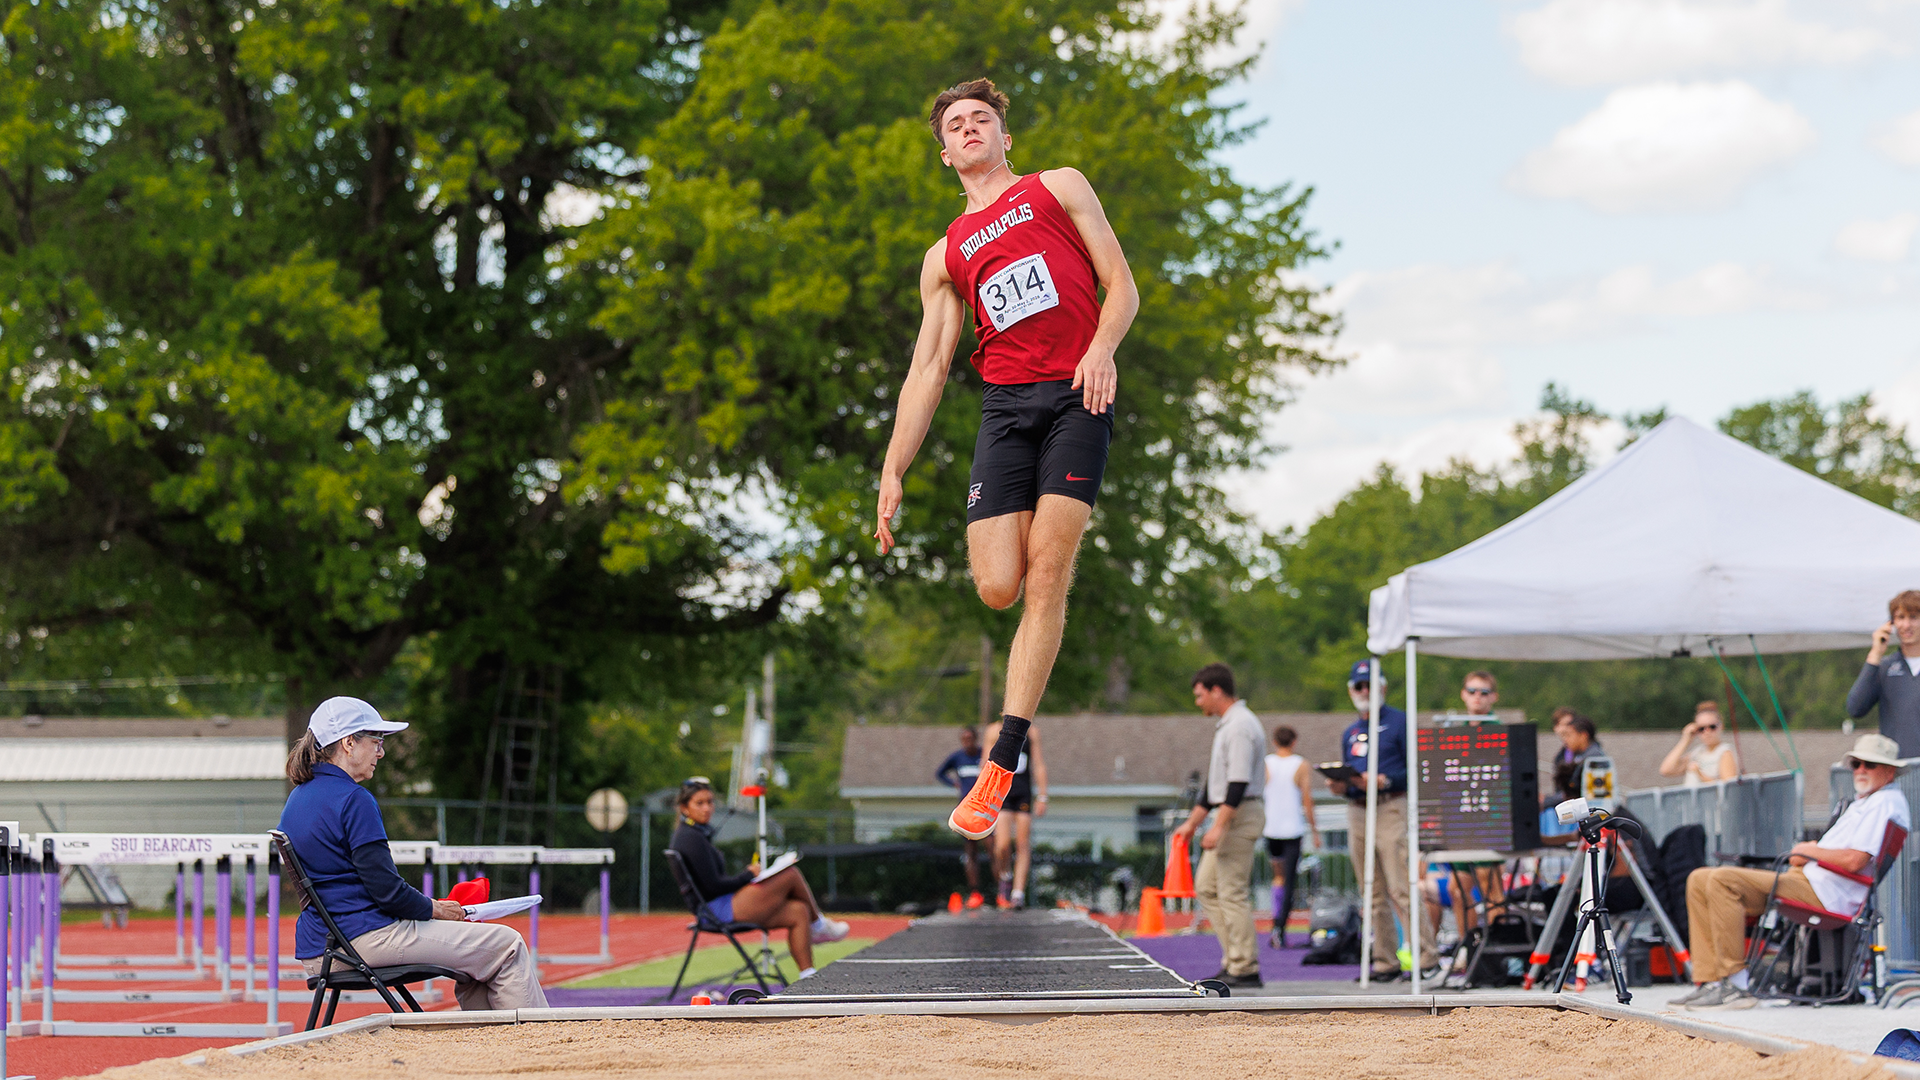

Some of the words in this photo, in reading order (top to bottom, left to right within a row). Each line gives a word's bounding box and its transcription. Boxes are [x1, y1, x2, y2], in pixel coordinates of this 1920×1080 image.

[959, 202, 1034, 262] INDIANAPOLIS
[986, 264, 1046, 312] 314
[111, 837, 138, 852] SBU
[143, 837, 212, 852] BEARCATS
[232, 841, 259, 849] UCS
[143, 1026, 176, 1035] UCS
